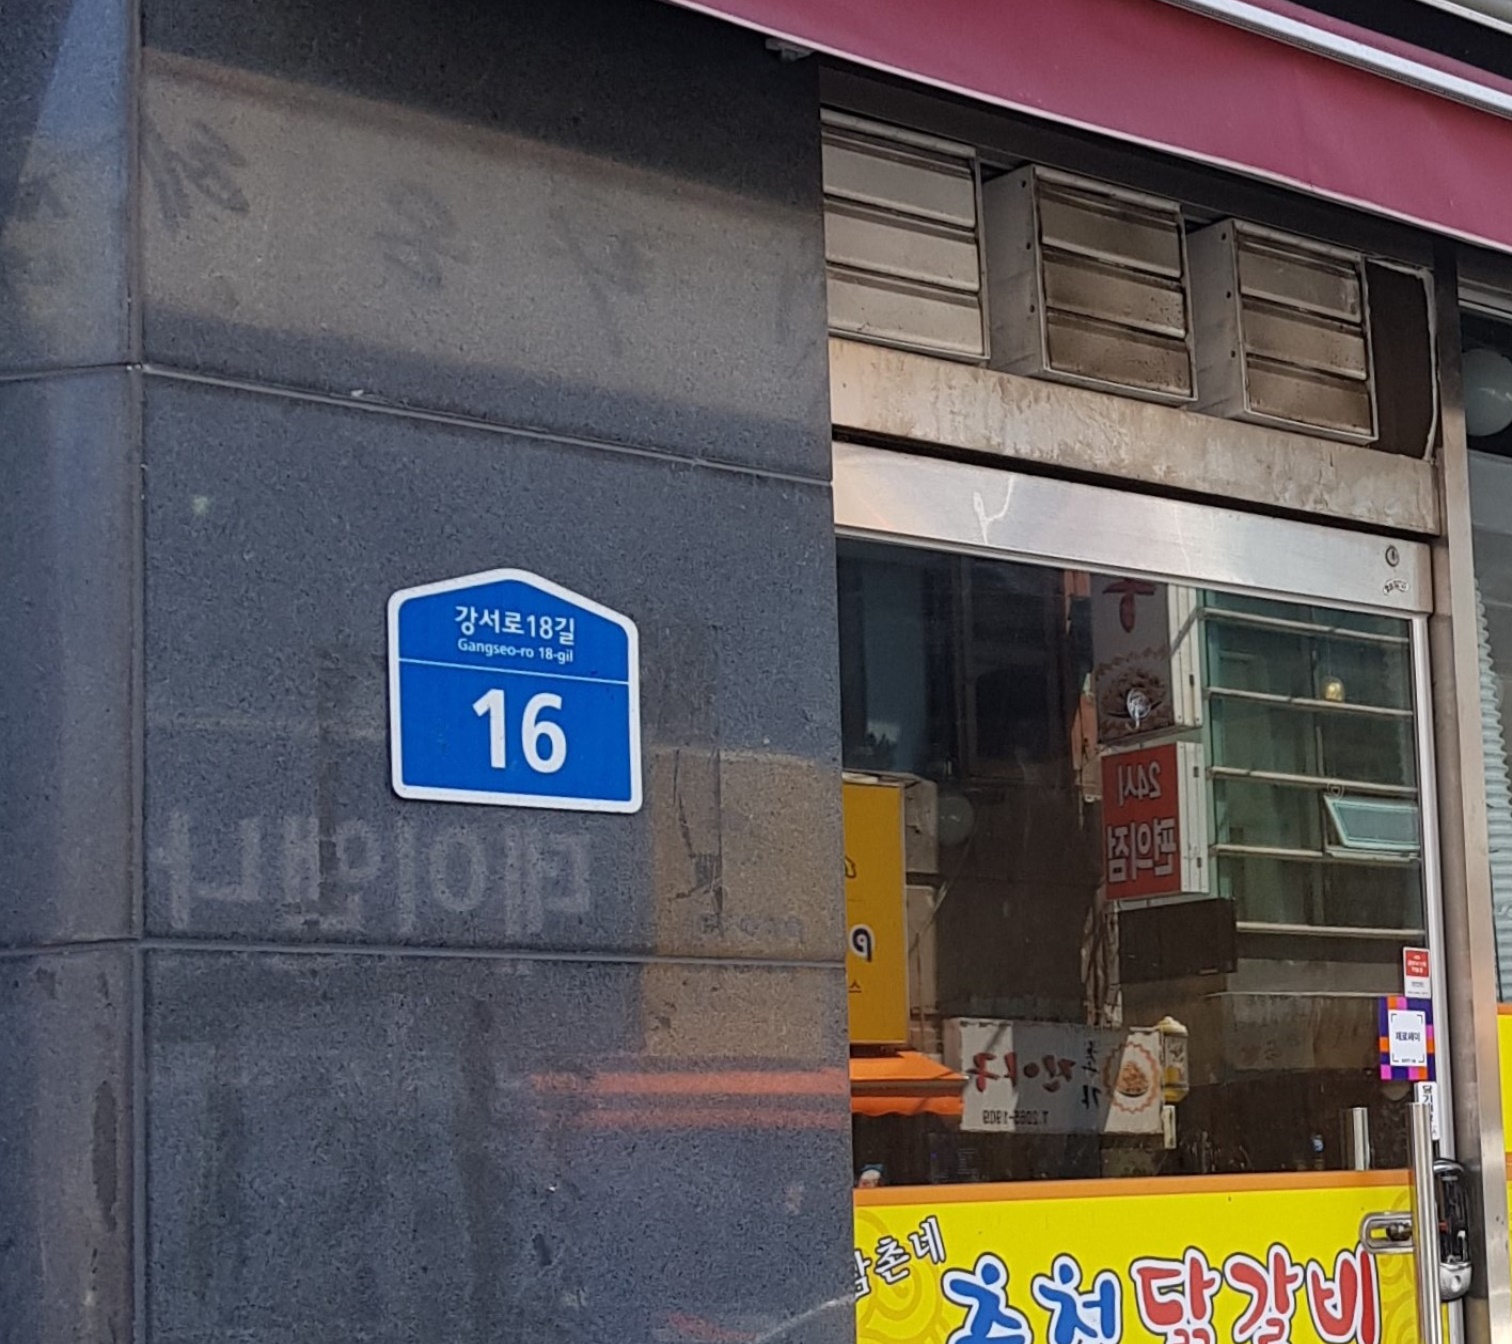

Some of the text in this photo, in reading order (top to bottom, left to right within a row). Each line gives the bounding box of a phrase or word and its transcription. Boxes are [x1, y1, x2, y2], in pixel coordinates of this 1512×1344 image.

[455, 606, 575, 645] 강서로18길
[458, 638, 573, 664] Gangseo-ro 18-gil
[472, 689, 567, 774] 16
